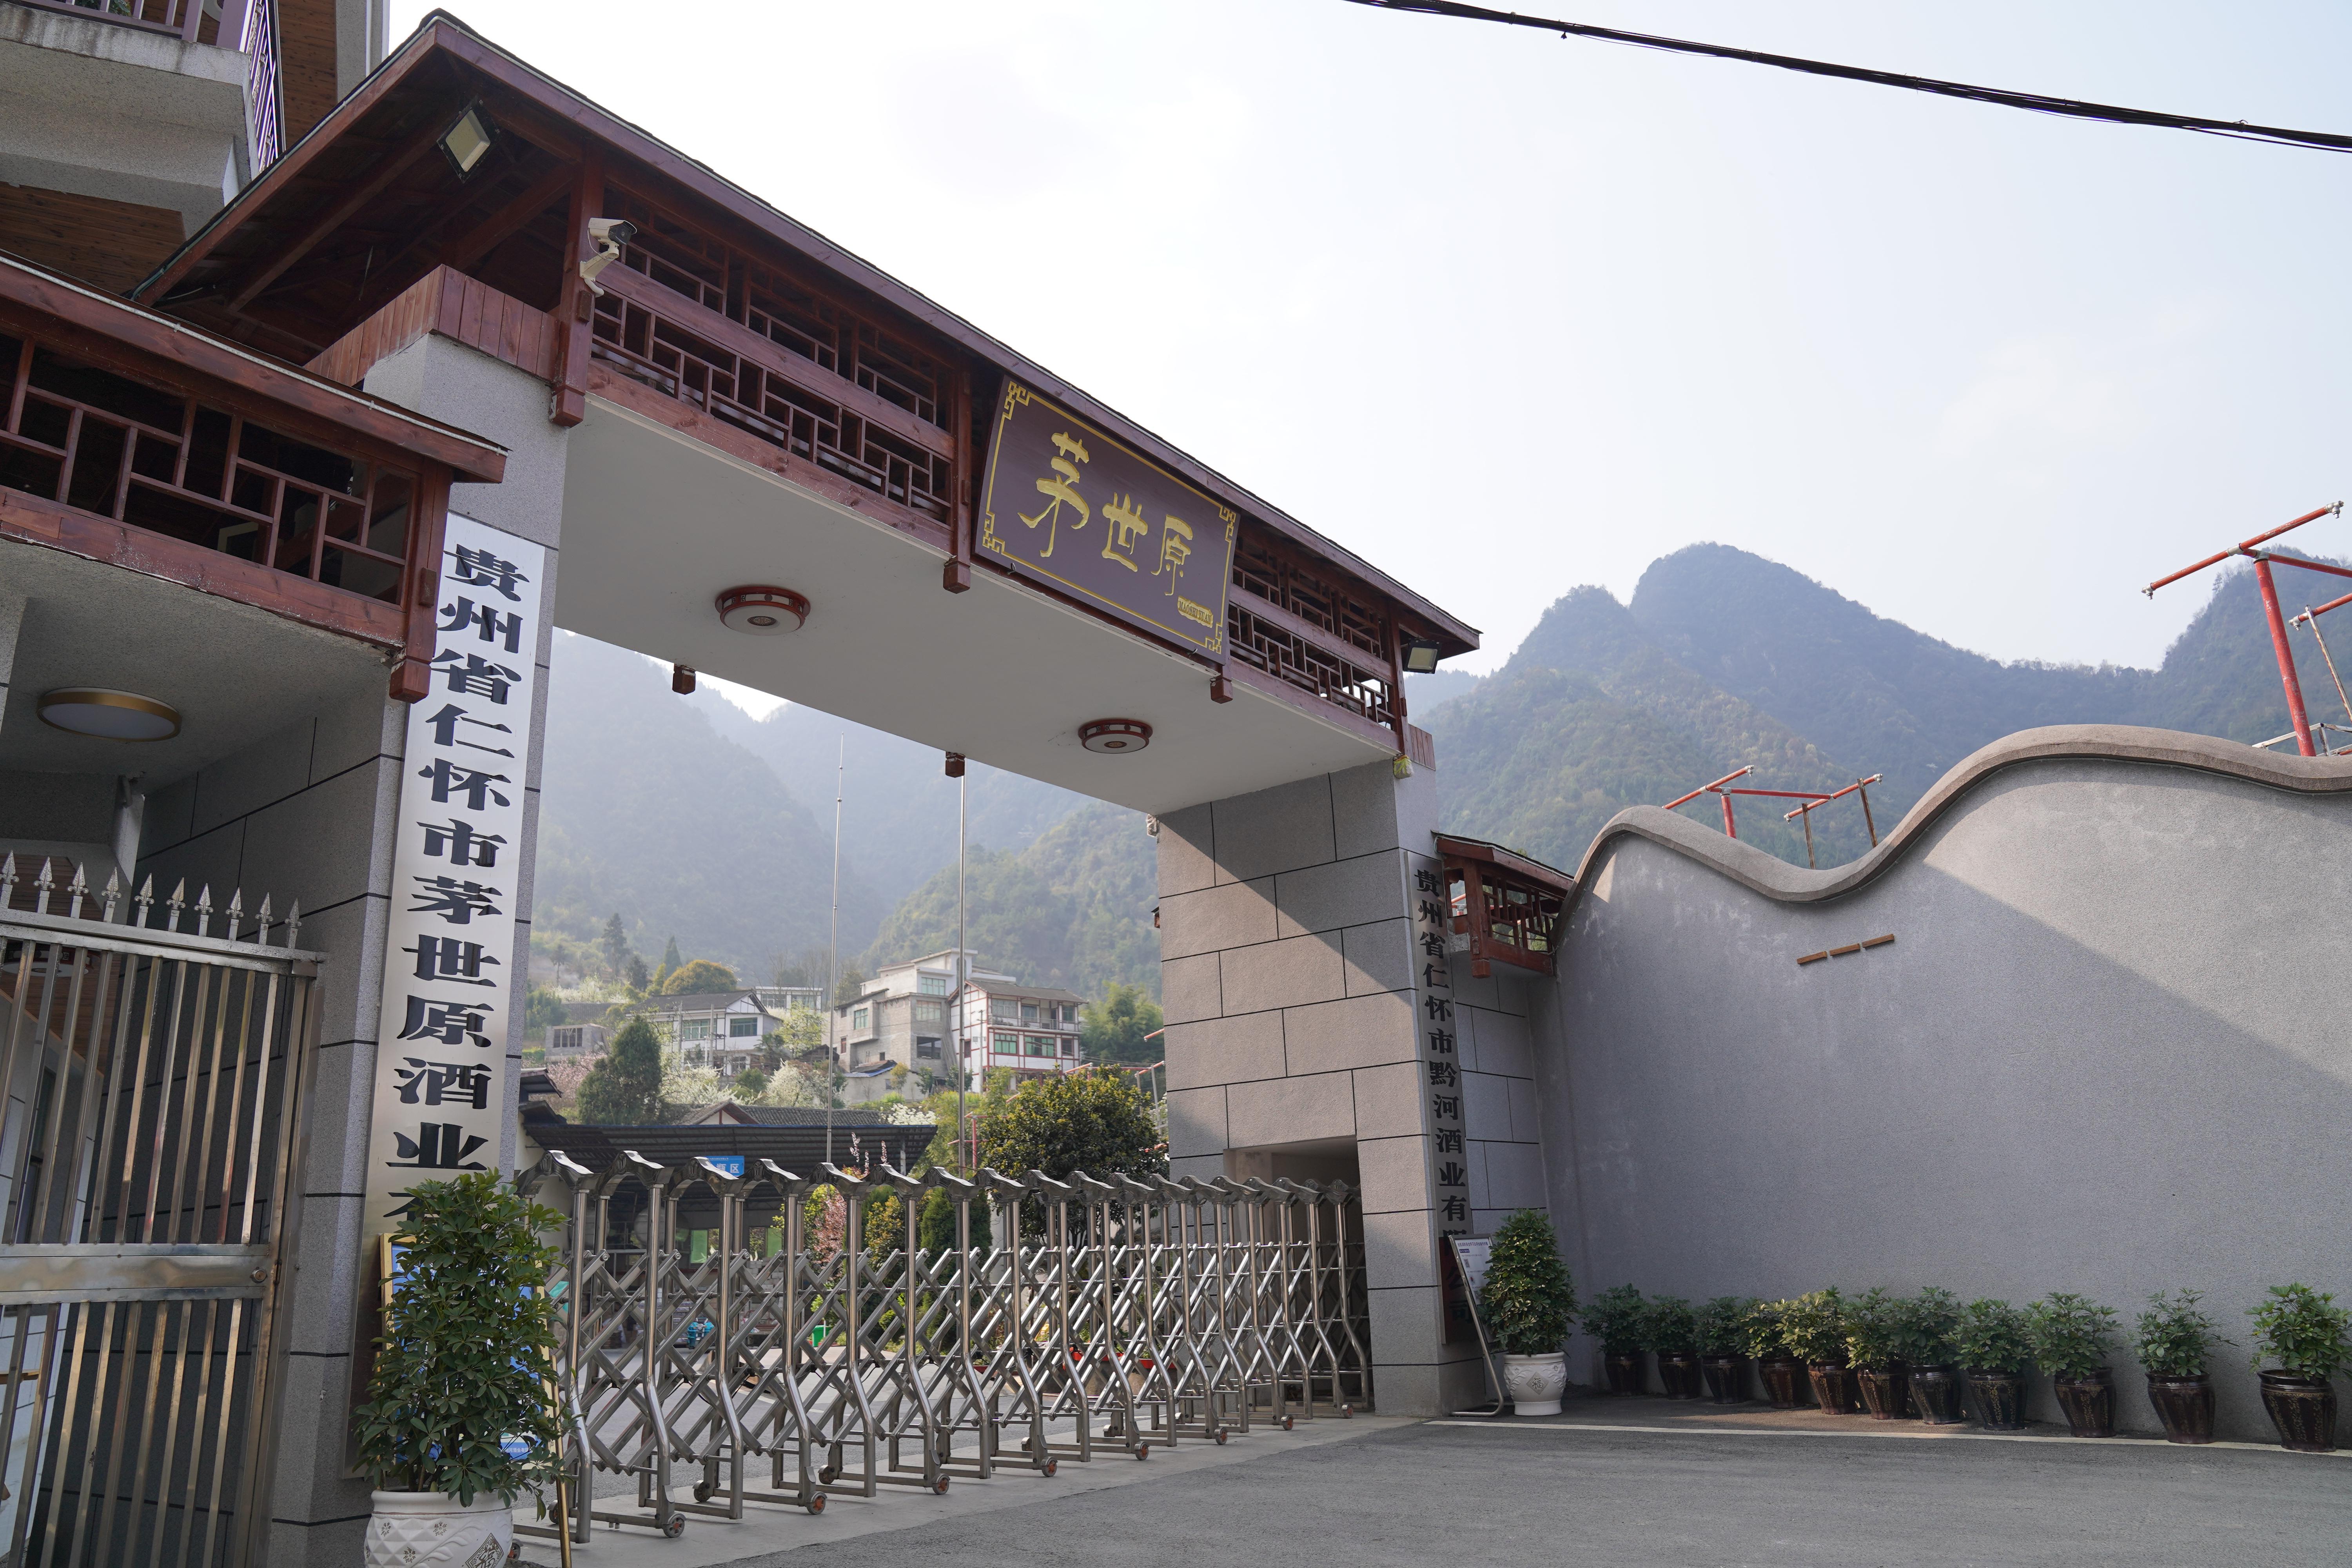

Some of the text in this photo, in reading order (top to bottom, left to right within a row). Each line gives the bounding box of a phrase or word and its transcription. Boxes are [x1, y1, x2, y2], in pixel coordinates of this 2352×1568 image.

[1018, 432, 1193, 596] 茅世原
[1179, 601, 1211, 622] MAOSHI YUAN
[1532, 1377, 1544, 1389] 福
